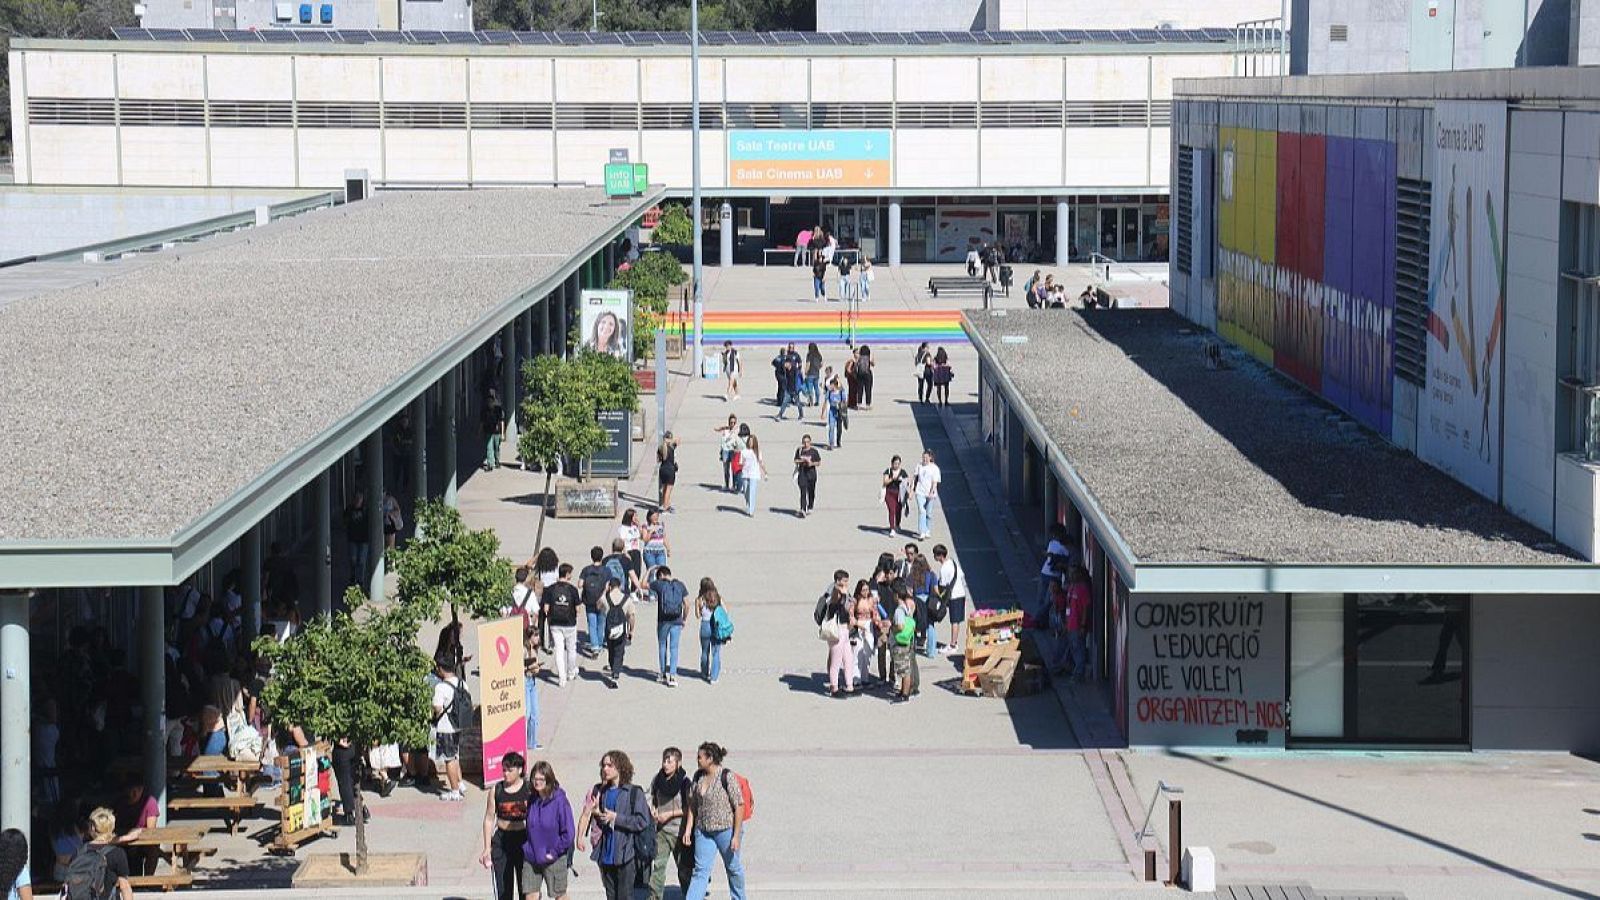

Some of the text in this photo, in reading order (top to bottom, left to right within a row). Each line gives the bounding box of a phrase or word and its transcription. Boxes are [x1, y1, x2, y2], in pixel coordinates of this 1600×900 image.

[736, 140, 835, 151] Sala Teatre UAB
[736, 168, 843, 180] Sala Cinema UAB
[1135, 596, 1263, 629] CONSTRUÏM
[1153, 629, 1260, 659] L'EDUCACIÓ
[490, 676, 517, 691] Centre
[1137, 665, 1243, 694] QUE VOLEM
[499, 690, 509, 701] de
[486, 699, 522, 716] Recursos
